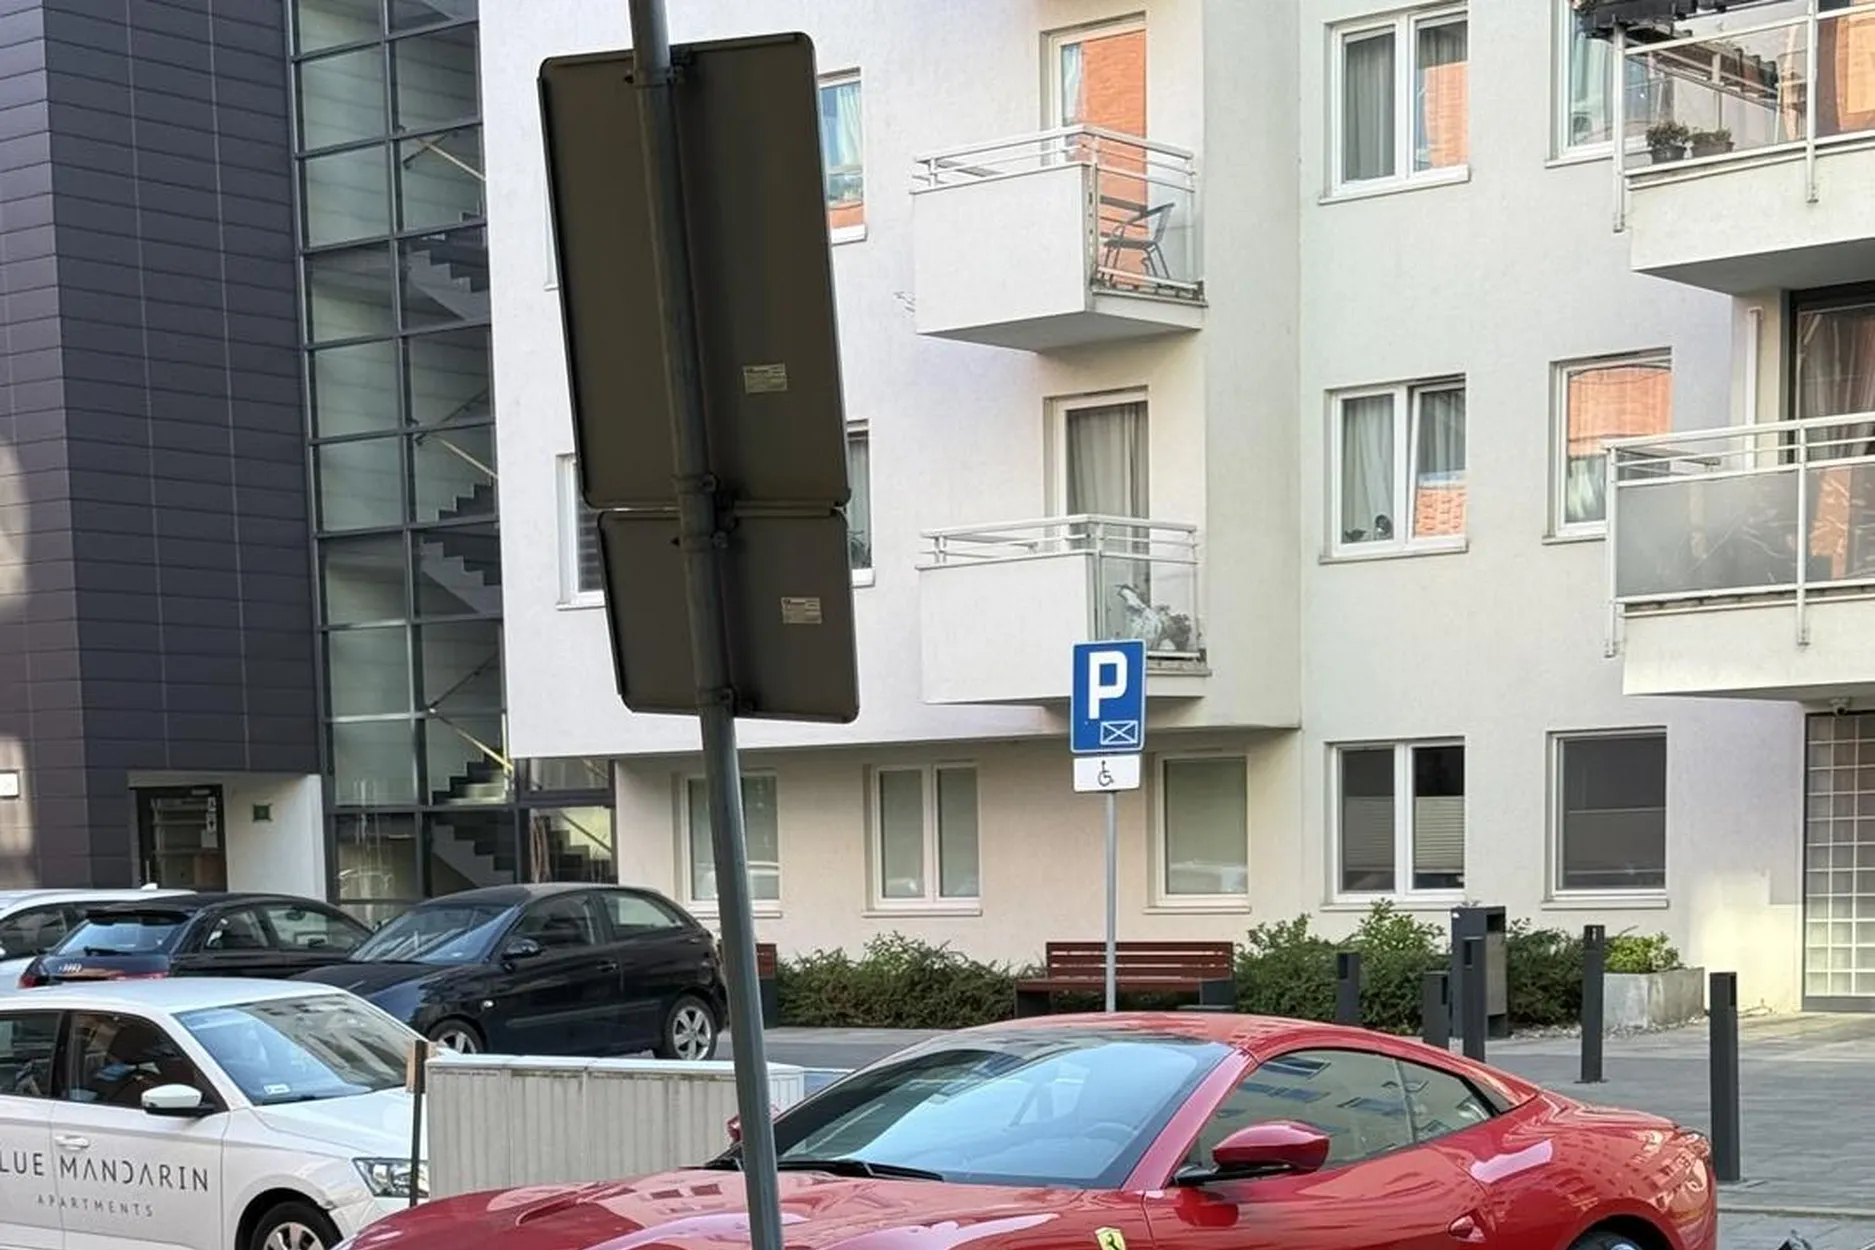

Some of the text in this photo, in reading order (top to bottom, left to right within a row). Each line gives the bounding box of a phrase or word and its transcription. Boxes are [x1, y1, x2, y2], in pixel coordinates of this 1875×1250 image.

[1088, 650, 1128, 720] P
[60, 1154, 209, 1192] MANDARIN
[37, 1193, 154, 1217] APARTMENTS
